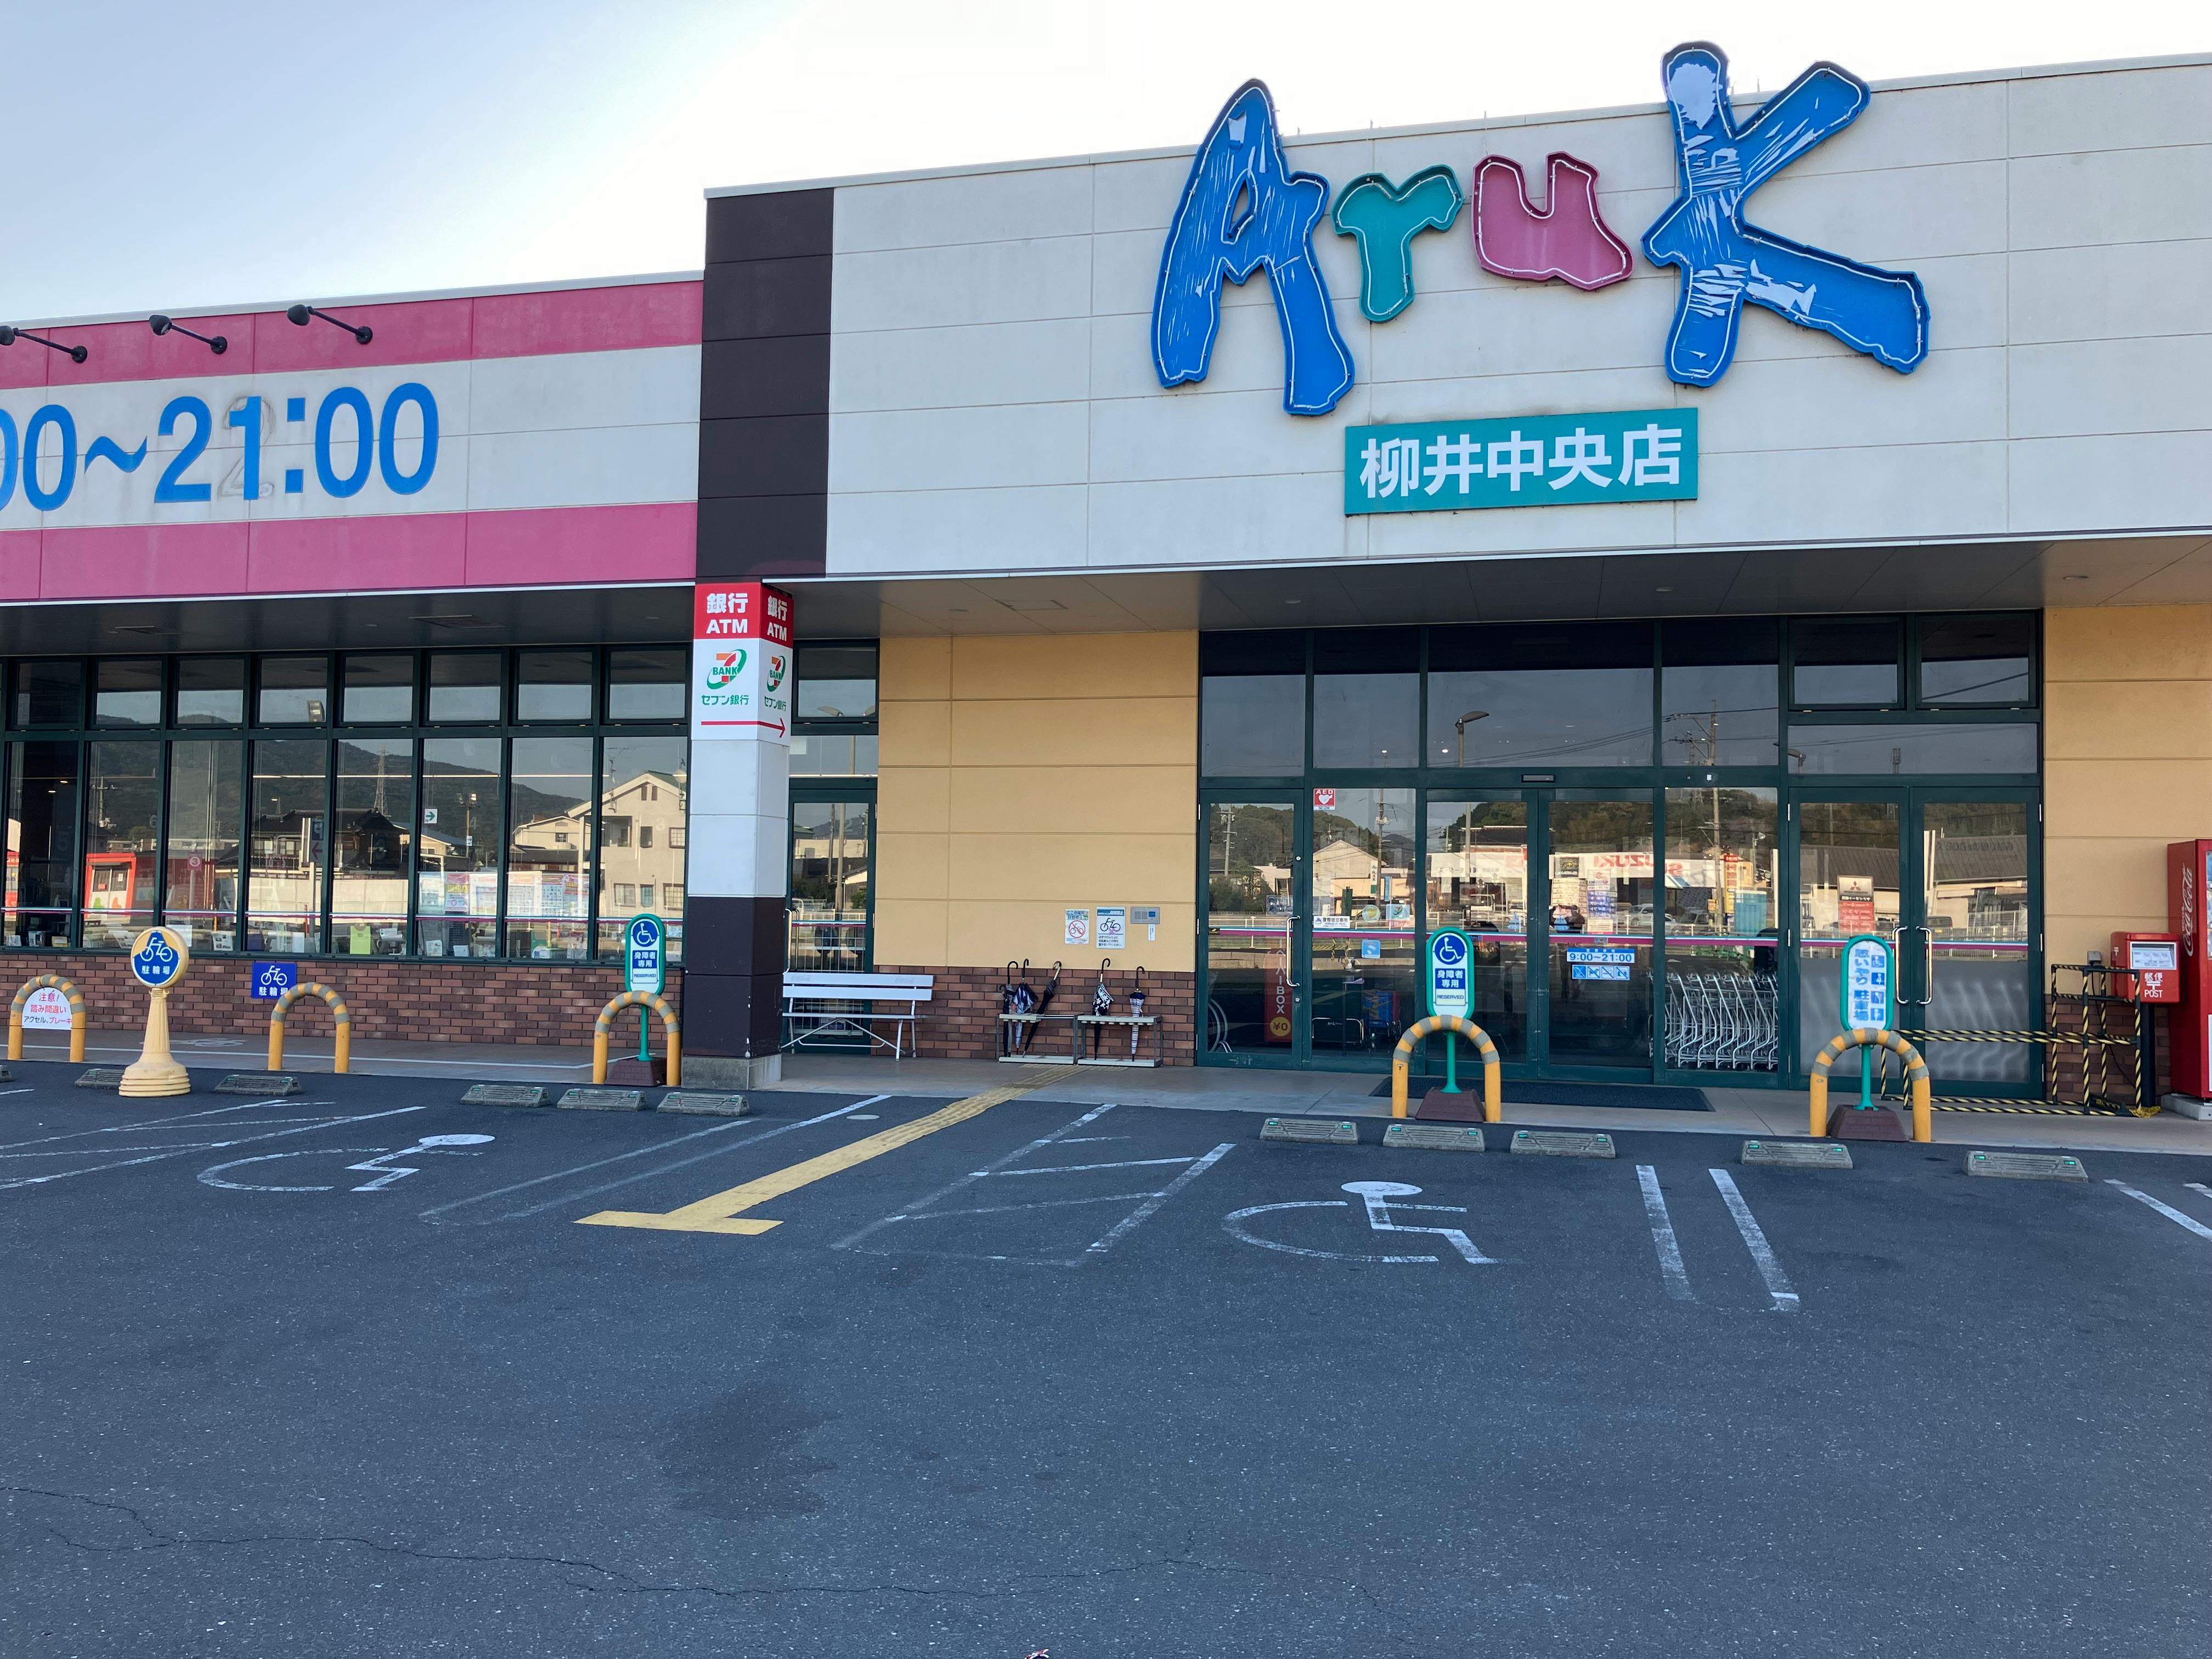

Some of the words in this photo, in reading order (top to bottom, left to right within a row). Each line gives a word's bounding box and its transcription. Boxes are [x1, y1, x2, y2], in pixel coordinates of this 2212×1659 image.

[1361, 424, 1683, 498] 柳井中央店
[707, 593, 748, 614] 銀行
[768, 596, 787, 621] 銀行
[706, 619, 748, 634] ATM
[767, 622, 787, 641] ATM
[713, 667, 738, 675] BANK
[770, 670, 782, 679] BANK
[701, 695, 749, 706] セブン銀行
[764, 696, 786, 712] セブン銀行
[142, 965, 170, 975] 駐輪場
[1437, 969, 1464, 978] 身障者
[2145, 972, 2163, 983] 郵便
[1441, 979, 1459, 988] 専用
[2145, 990, 2163, 998] POST
[31, 1004, 66, 1014] 踏み間違い
[1273, 1023, 1288, 1031] ¥0
